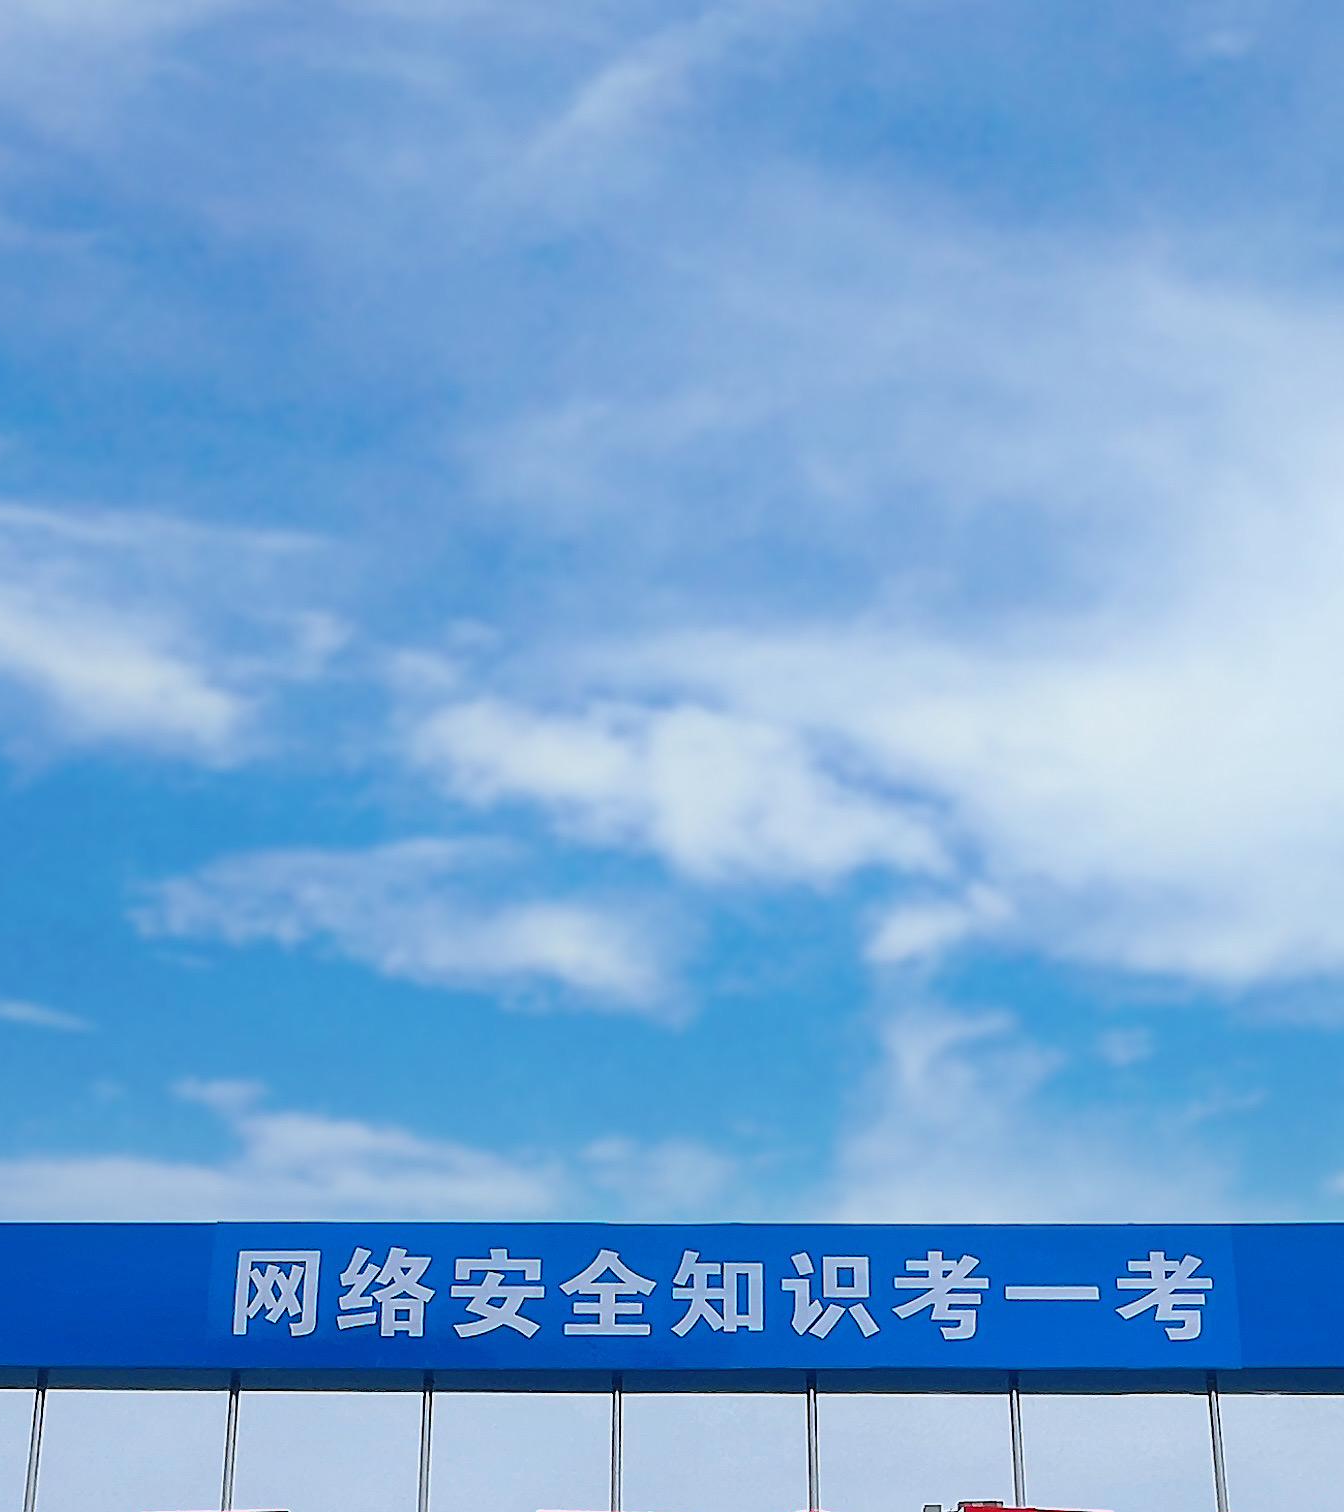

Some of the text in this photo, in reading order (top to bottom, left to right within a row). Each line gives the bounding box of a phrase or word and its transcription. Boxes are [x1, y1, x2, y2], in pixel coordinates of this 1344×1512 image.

[231, 1246, 1214, 1339] 网络安全知识考一考
